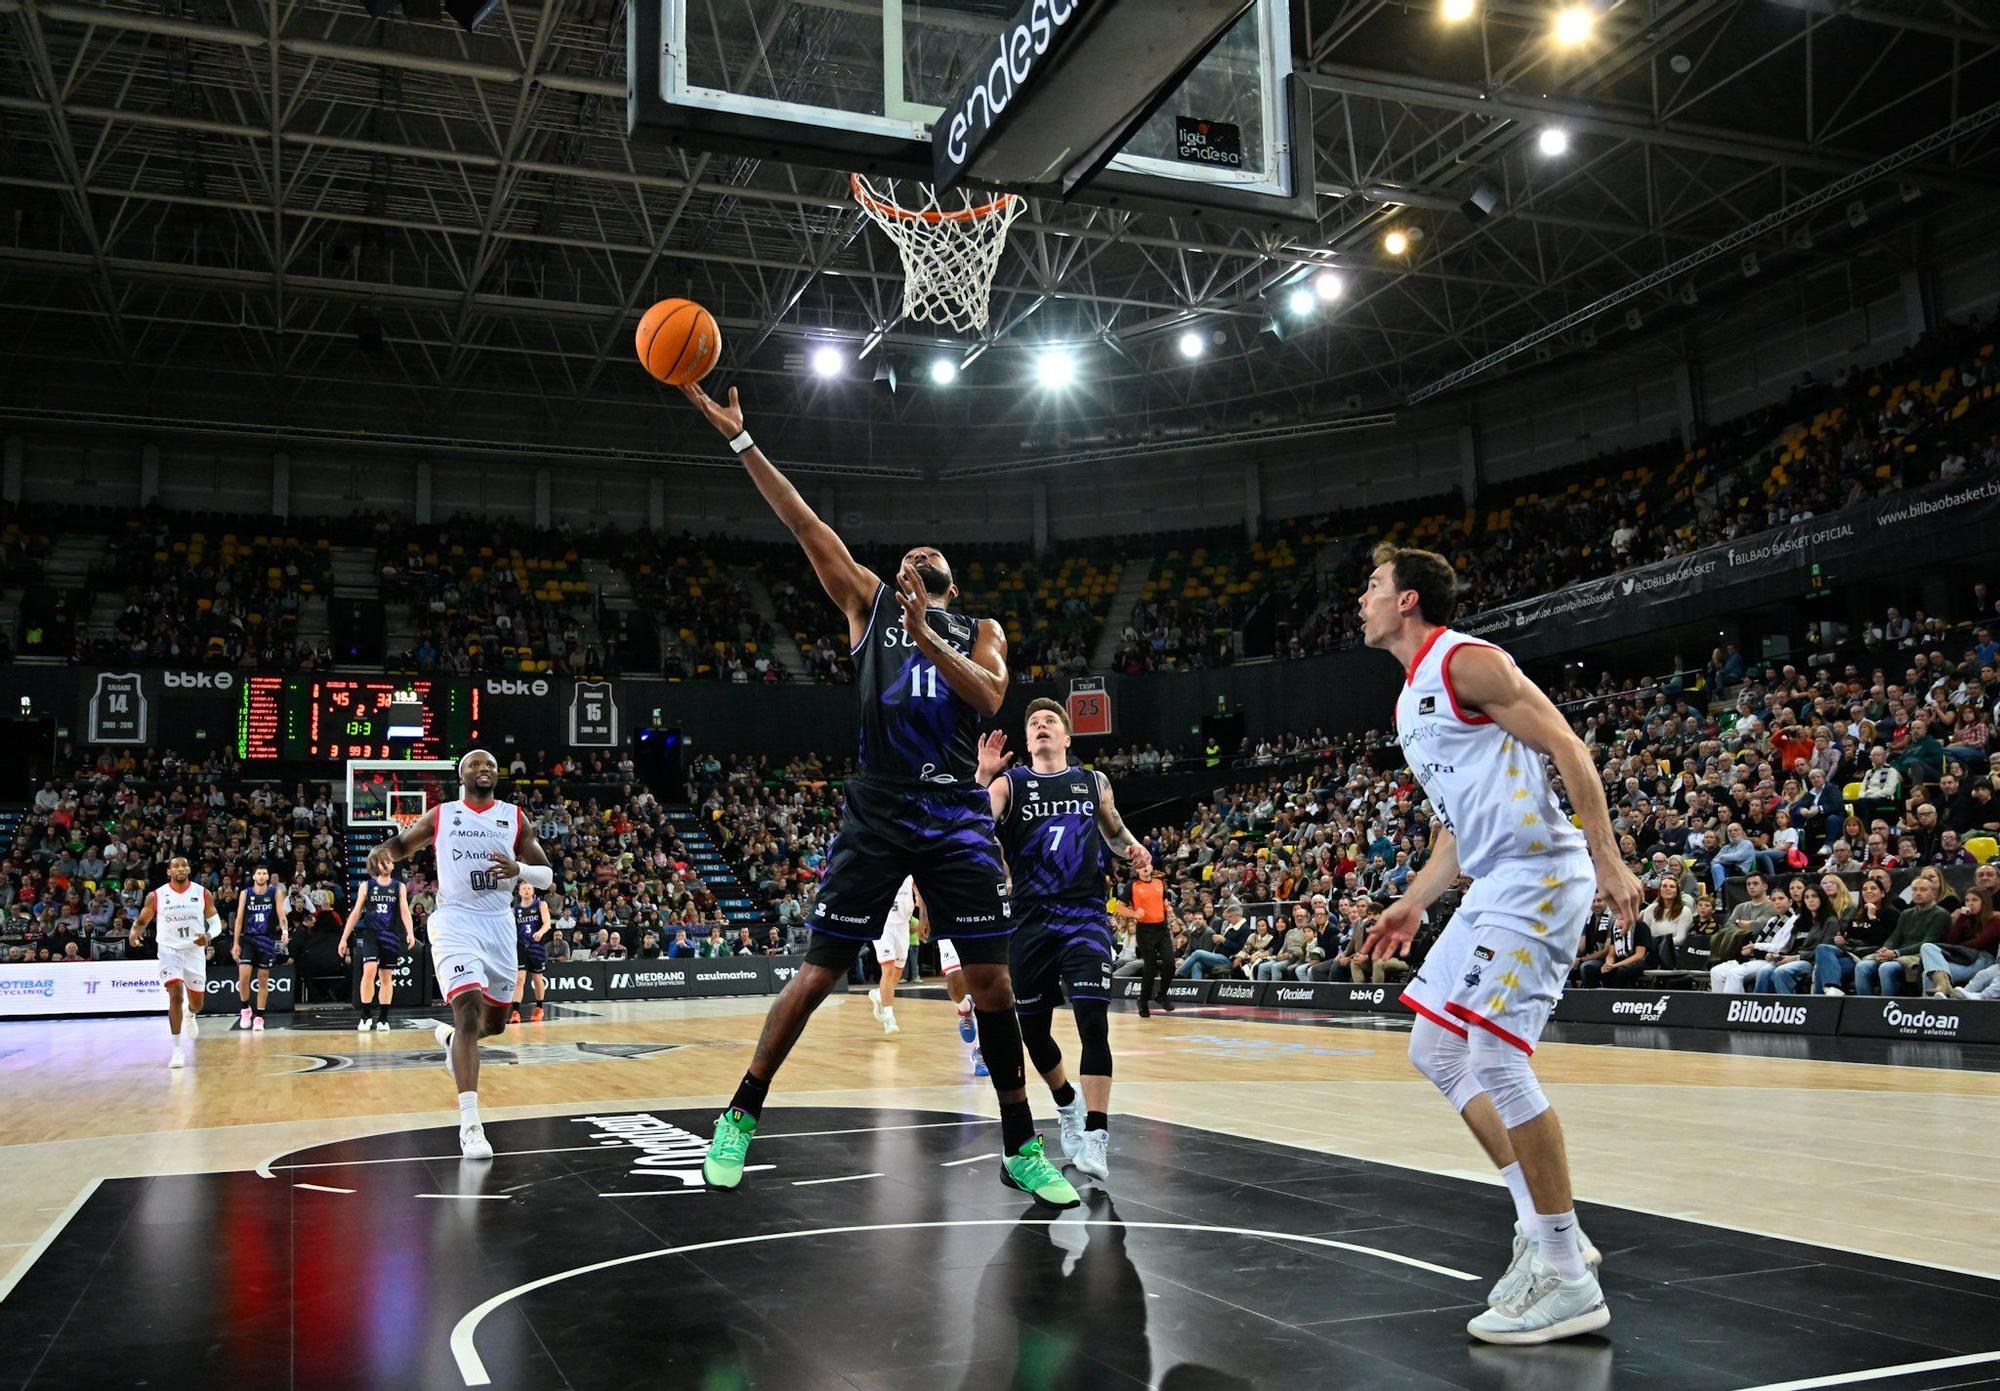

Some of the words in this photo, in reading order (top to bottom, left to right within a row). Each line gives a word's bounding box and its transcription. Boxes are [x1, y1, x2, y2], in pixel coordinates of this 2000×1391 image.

[1179, 129, 1206, 146] liga
[1180, 145, 1239, 164] endesa
[1772, 535, 1810, 555] BASKET
[1812, 525, 1855, 545] OFICIAL
[164, 671, 213, 688] bbk
[911, 664, 937, 698] 11
[486, 679, 530, 695] bbk
[108, 694, 128, 713] 14
[1077, 698, 1099, 716] 25
[586, 703, 602, 721] 15
[1021, 799, 1094, 821] surne
[1049, 826, 1065, 851] 7
[370, 894, 397, 902] surne
[247, 903, 272, 911] surne
[376, 904, 389, 913] 32
[254, 913, 265, 922] 18
[830, 913, 840, 922] EL
[840, 915, 867, 924] CORREO
[956, 915, 995, 923] NISSAN
[177, 926, 190, 938] 11
[525, 924, 531, 933] 3
[635, 971, 685, 981] MEDRANO
[696, 970, 757, 981] azulmarino
[111, 979, 160, 988] Trienekens
[206, 978, 291, 994] enesa
[550, 976, 594, 990] IMQ
[1166, 987, 1199, 996] NISSAN
[1218, 984, 1255, 998] kutxabank
[1283, 988, 1314, 1000] Occident
[1349, 990, 1373, 1000] bbk
[1640, 1014, 1661, 1022] SPORT
[1726, 1000, 1807, 1025] Bilbobus
[1887, 1009, 1959, 1030] Ondoan
[1924, 1028, 1957, 1036] solutions
